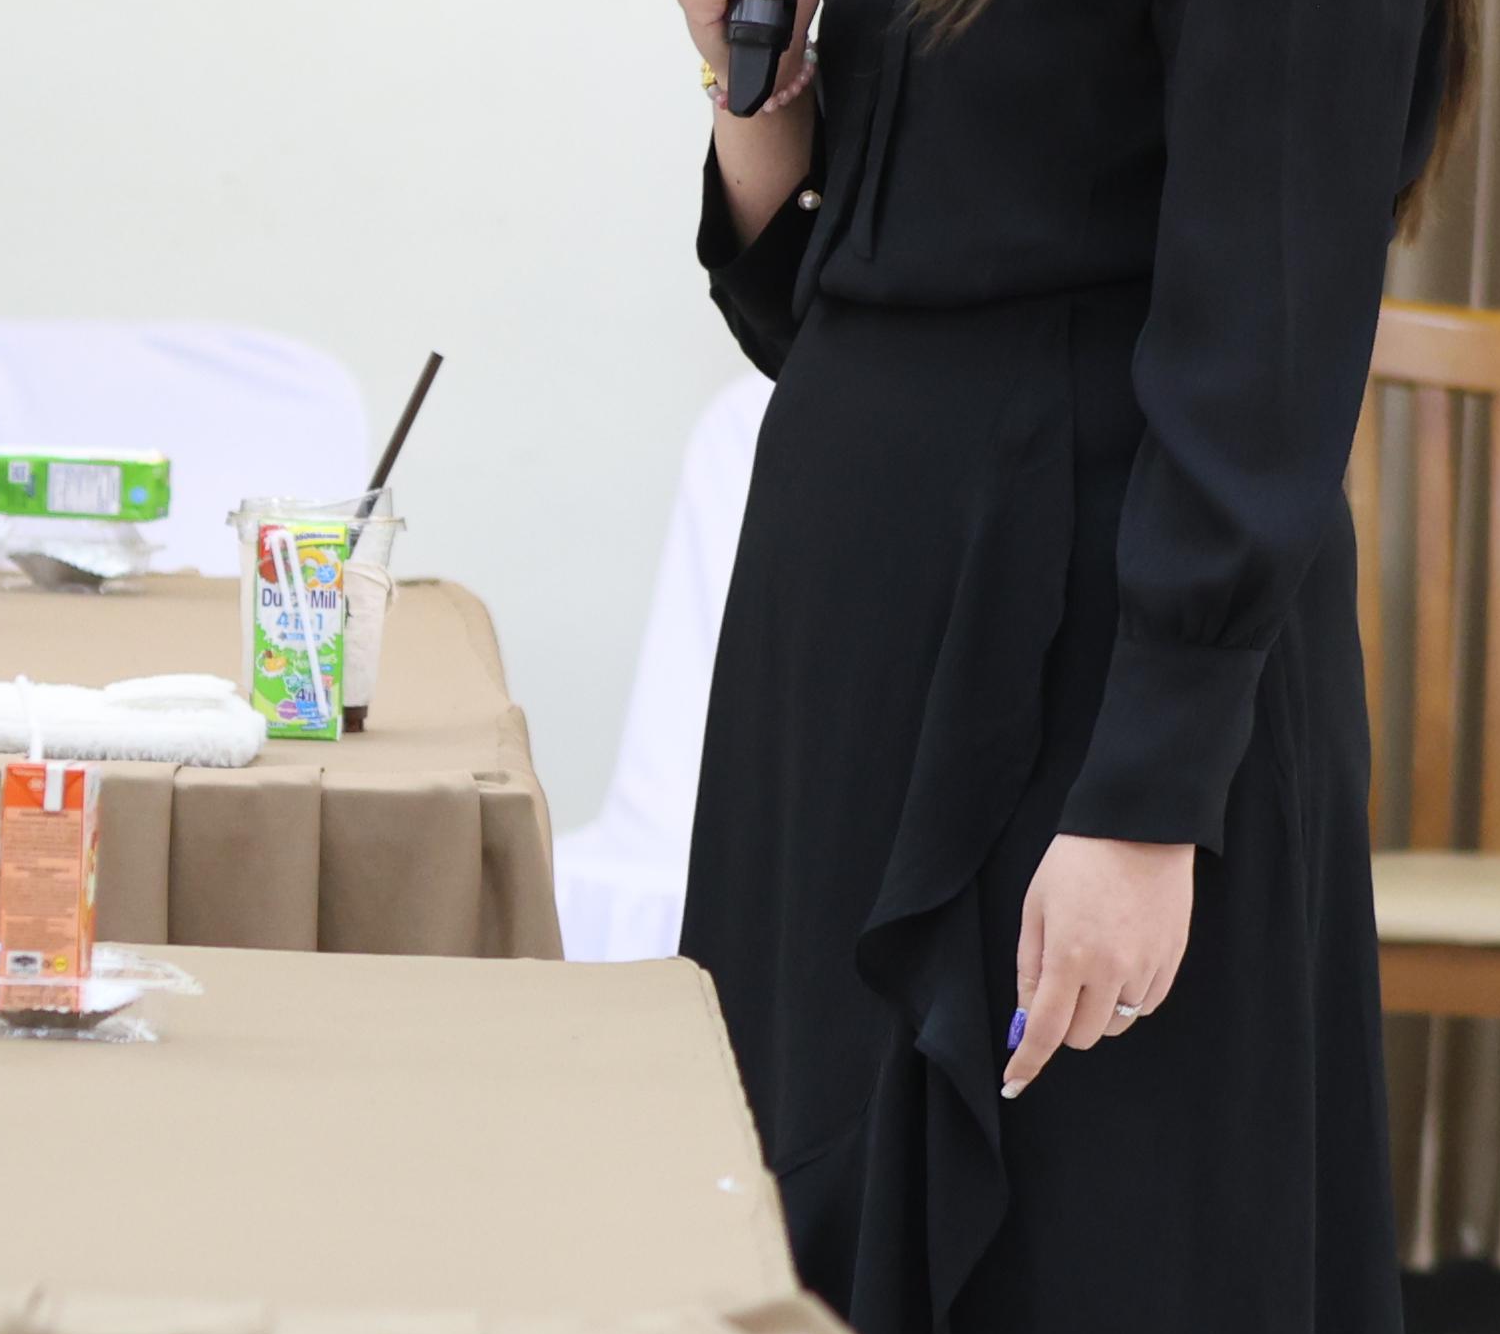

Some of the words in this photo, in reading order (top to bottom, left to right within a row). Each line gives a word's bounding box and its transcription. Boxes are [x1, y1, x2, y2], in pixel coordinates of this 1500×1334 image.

[311, 589, 336, 609] Mill
[276, 610, 289, 628] 4
[316, 613, 323, 631] 1
